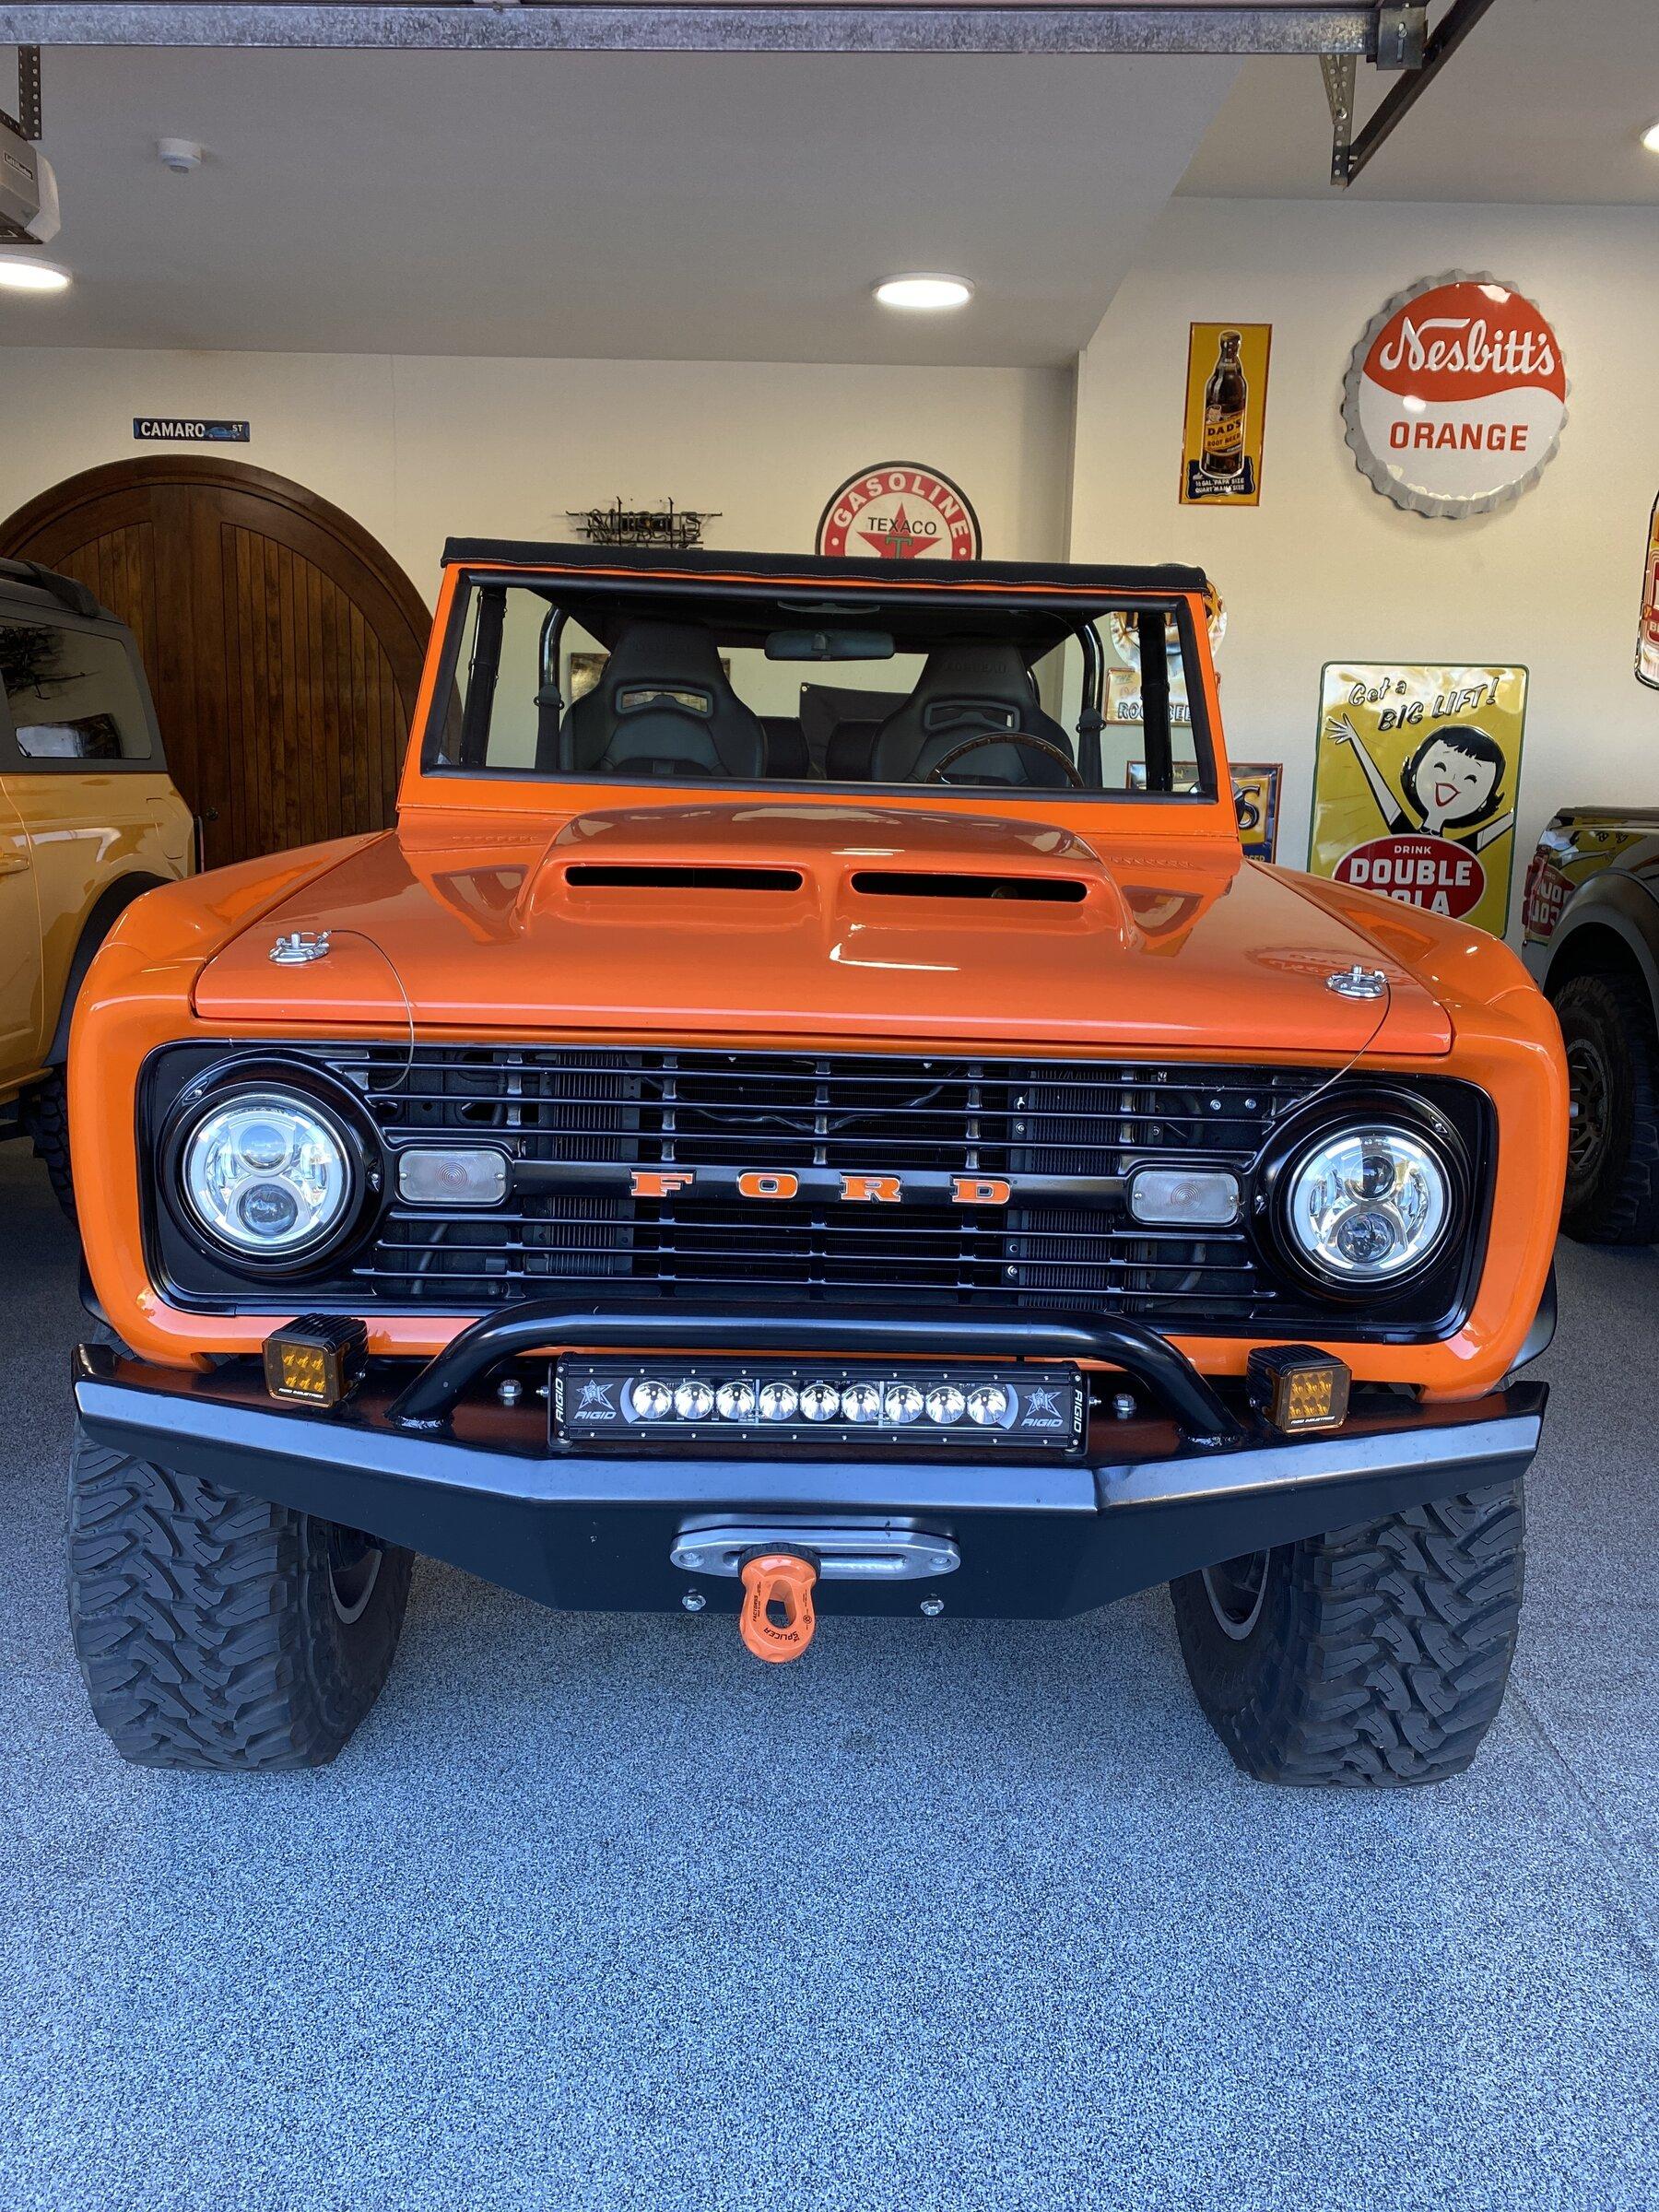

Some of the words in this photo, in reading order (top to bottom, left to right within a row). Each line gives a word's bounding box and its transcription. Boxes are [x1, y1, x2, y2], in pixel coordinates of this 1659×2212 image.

[1379, 316, 1555, 376] Nesbitt's
[140, 421, 206, 437] CAMARO
[232, 424, 243, 432] ST
[1207, 419, 1241, 436] DAD'S
[1389, 421, 1528, 451] ORANGE
[1207, 439, 1223, 447] ROOT
[833, 473, 969, 538] GASOLINE
[867, 516, 937, 535] TEXACO
[1348, 677, 1391, 706] Get
[1395, 680, 1407, 695] a
[1378, 701, 1425, 731] BIG
[1431, 677, 1500, 718] LIFT!
[1394, 845, 1431, 854] DRINK
[1349, 858, 1473, 887] DOUBLE
[629, 1169, 1012, 1205] FORD
[555, 1378, 564, 1422] RIGID
[1074, 1389, 1083, 1433] RIGID
[574, 1411, 618, 1419] RIGID
[1020, 1418, 1064, 1427] RIGID
[763, 1628, 799, 1642] SPLICER
